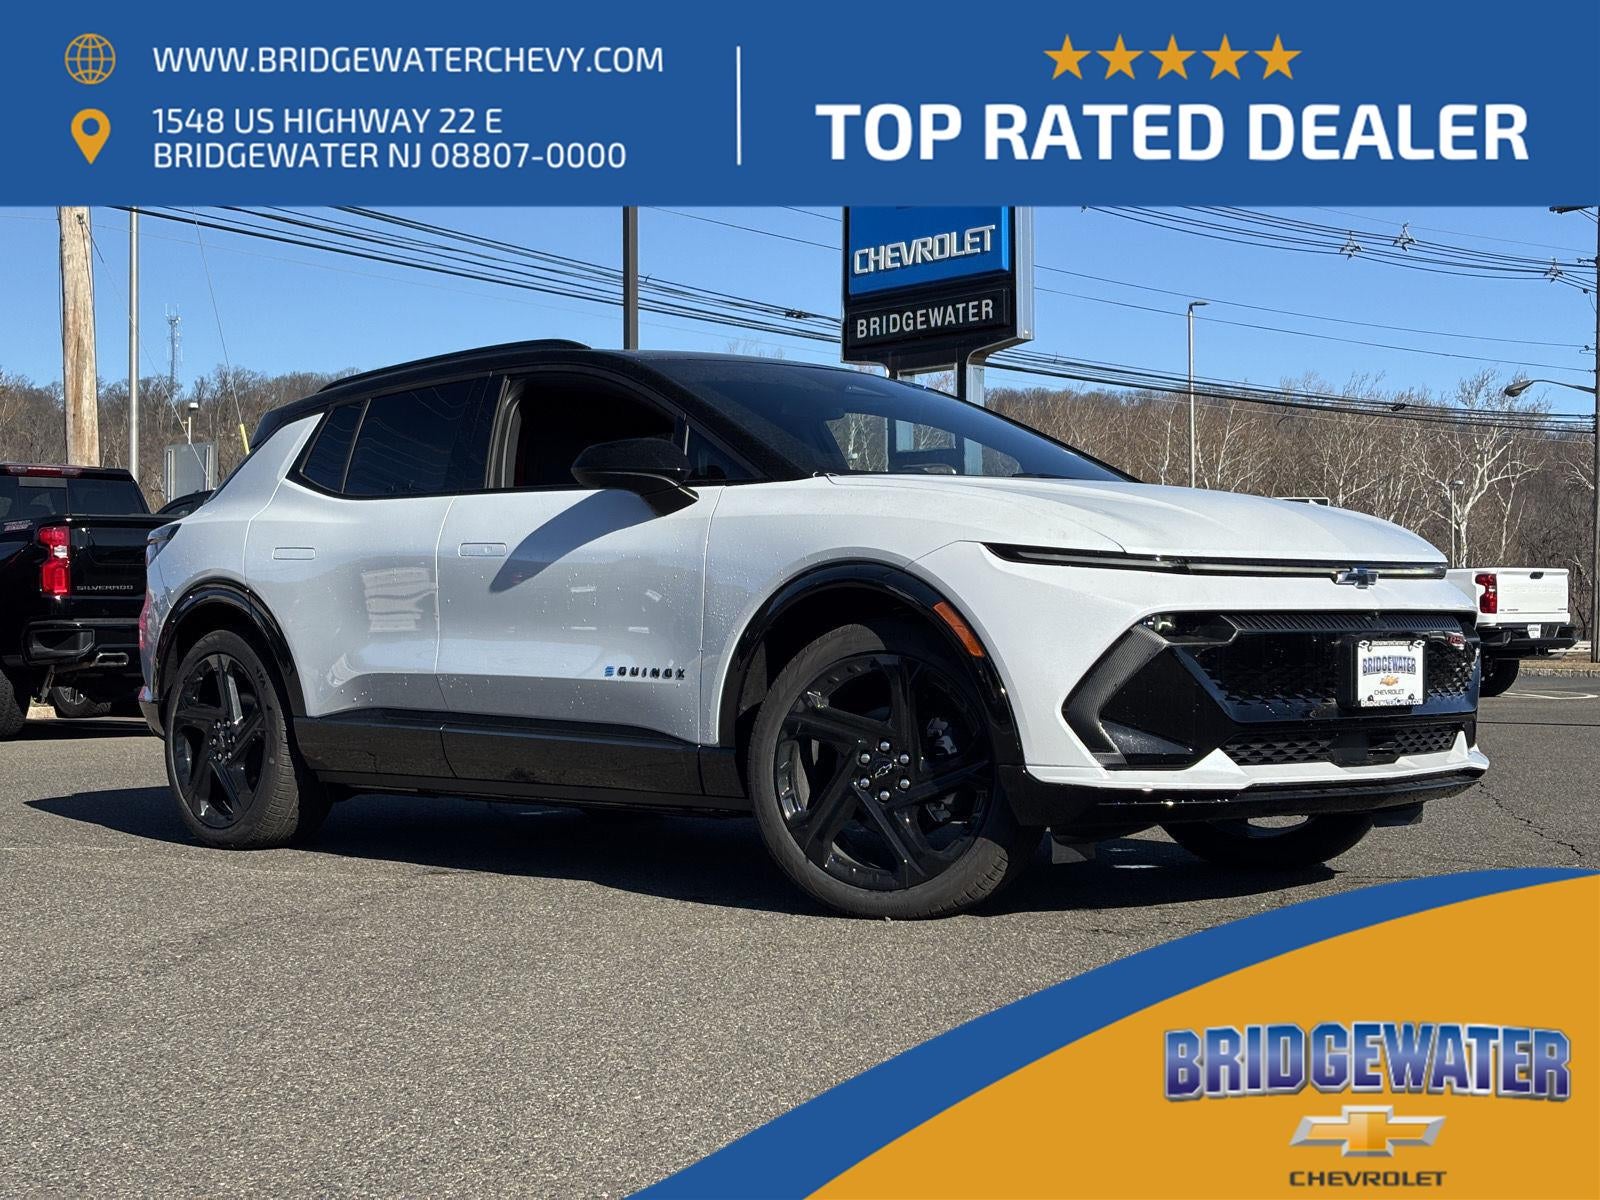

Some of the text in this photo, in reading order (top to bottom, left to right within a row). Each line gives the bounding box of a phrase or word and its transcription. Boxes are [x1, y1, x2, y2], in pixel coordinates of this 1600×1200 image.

[854, 224, 996, 275] CHEVROLET
[856, 299, 993, 339] BRIDGEWATER
[604, 665, 686, 680] EQUINOX
[1362, 655, 1417, 675] BRIDGEWATER
